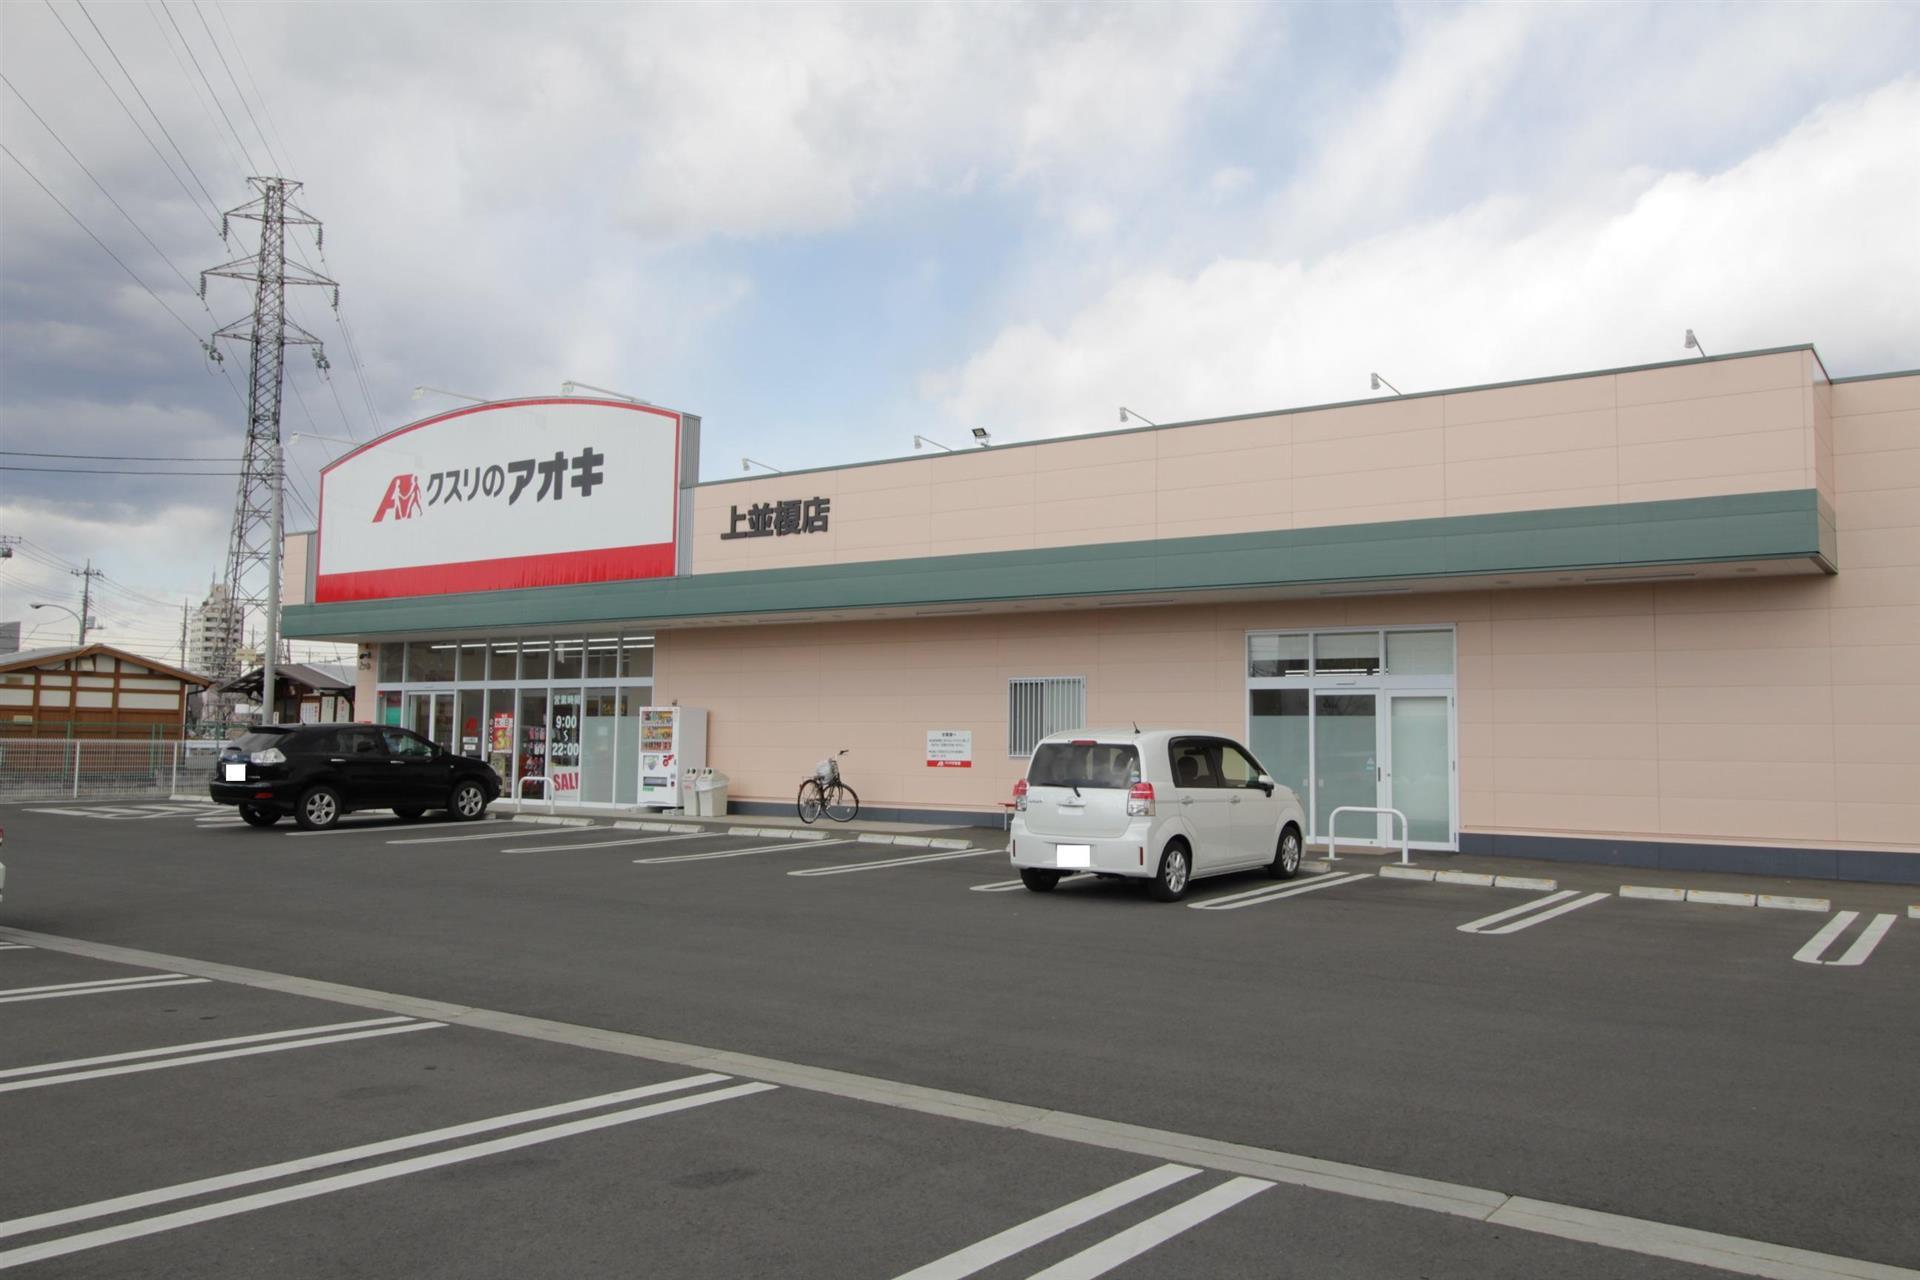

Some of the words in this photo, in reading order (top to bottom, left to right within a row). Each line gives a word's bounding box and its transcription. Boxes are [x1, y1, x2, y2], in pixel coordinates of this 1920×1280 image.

[426, 447, 604, 506] クスリのアオキ
[720, 496, 830, 540] 上並榎店
[555, 715, 577, 729] 9:00
[552, 743, 579, 756] 22:00
